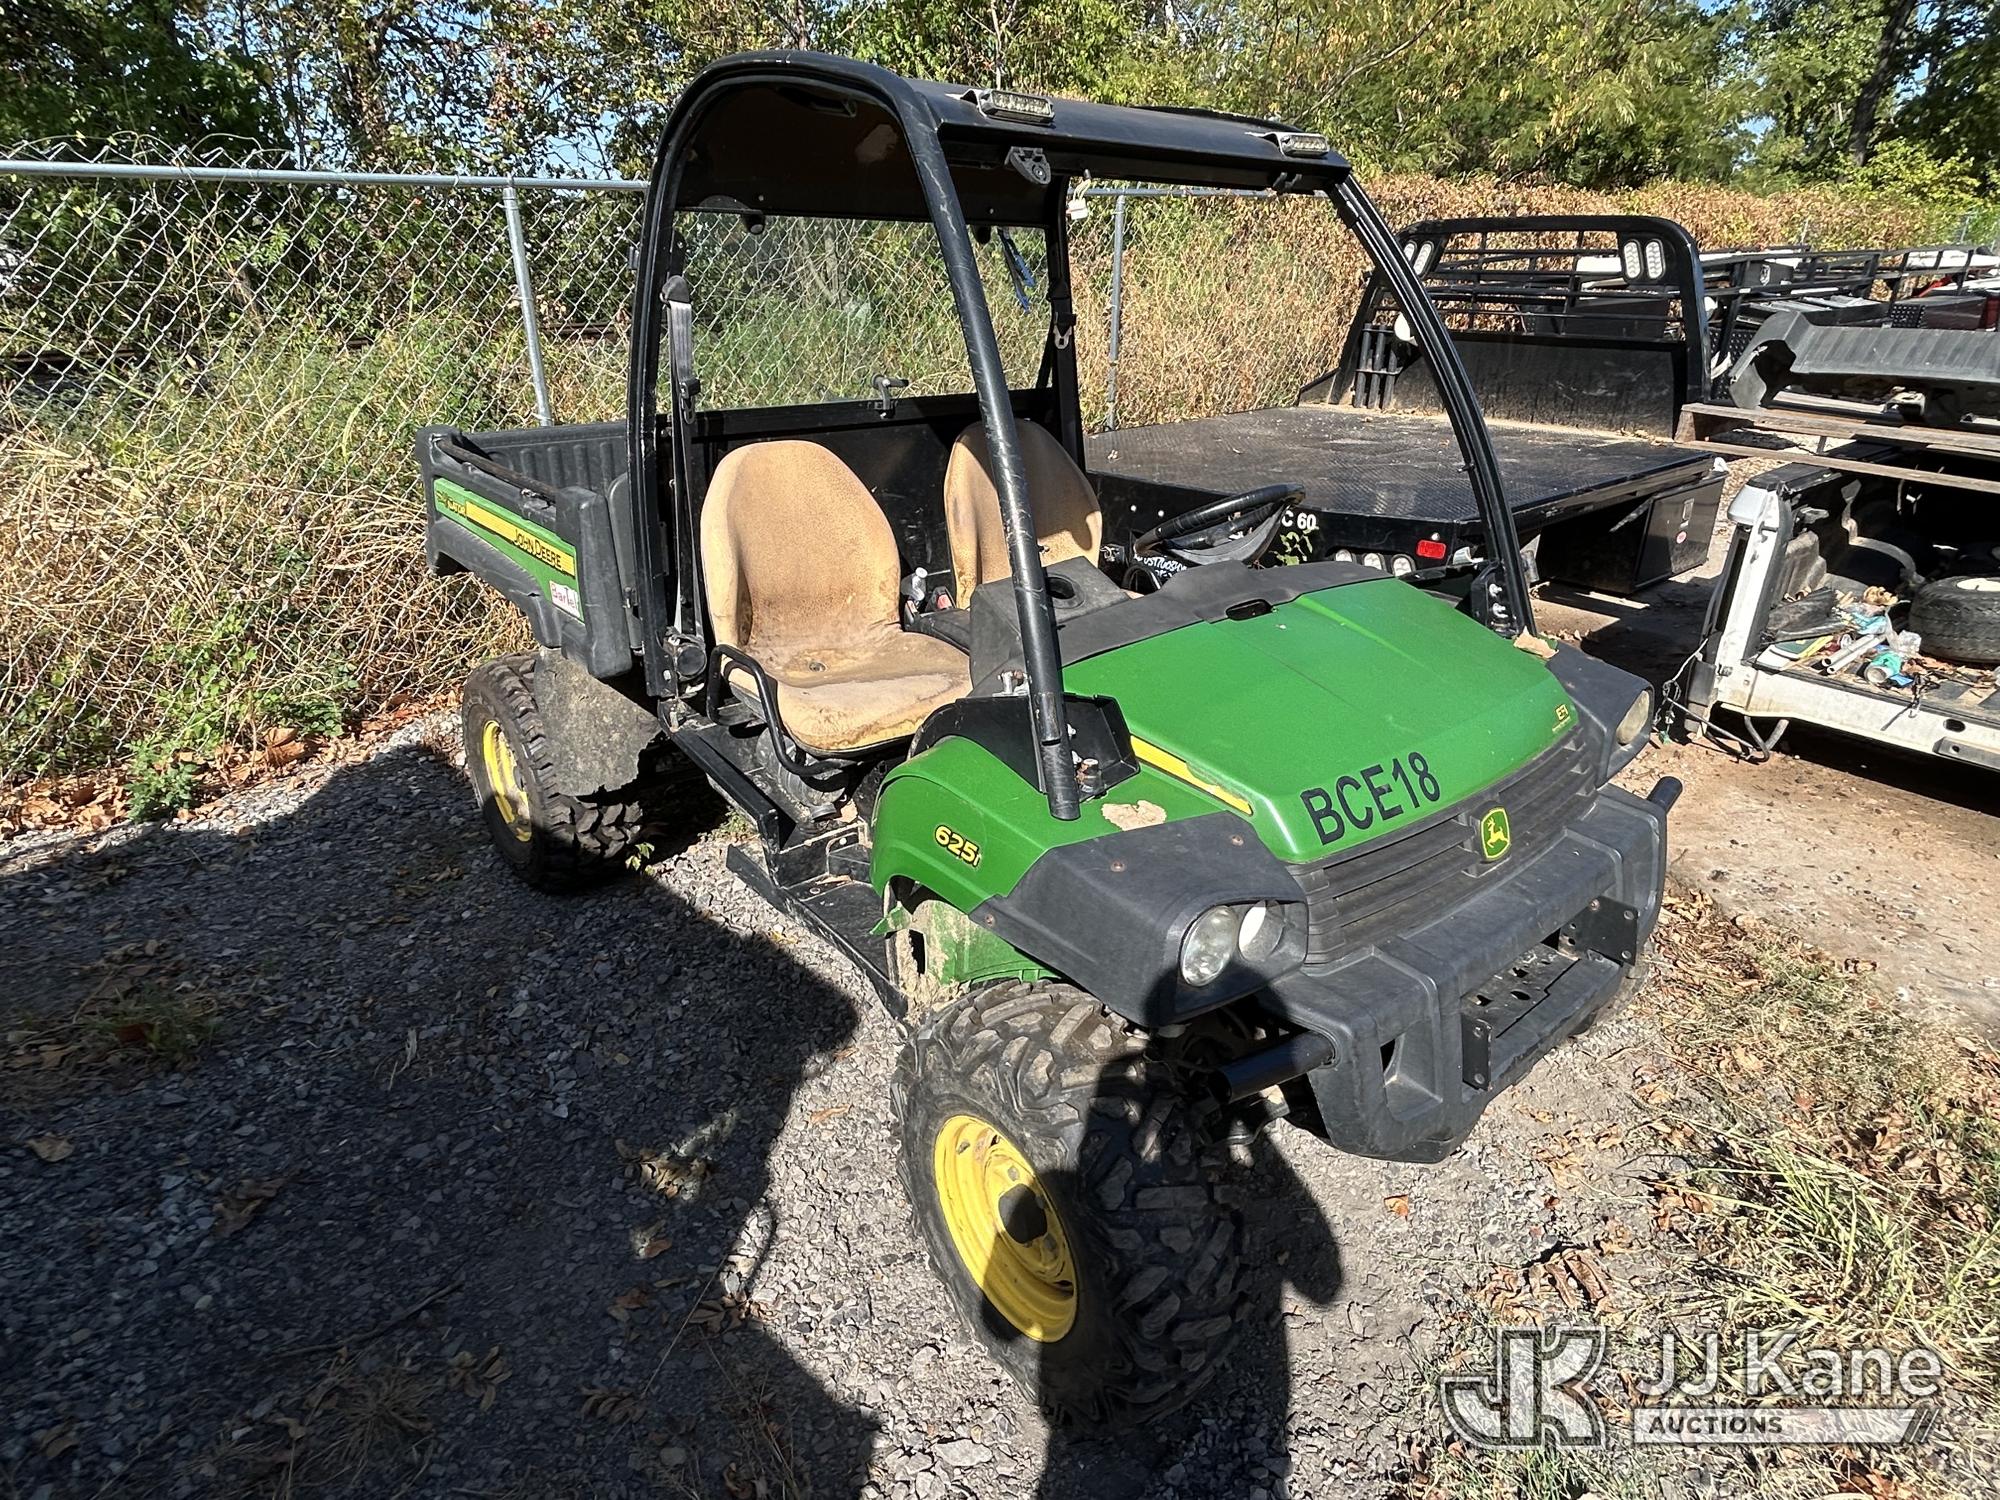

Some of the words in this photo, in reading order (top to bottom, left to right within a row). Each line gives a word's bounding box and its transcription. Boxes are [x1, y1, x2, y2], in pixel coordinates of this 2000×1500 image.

[1297, 512, 1317, 530] 60
[513, 528, 534, 555] JOHN
[533, 539, 562, 570] DEERE
[1300, 752, 1441, 845] BCE18
[935, 825, 981, 867] 625i
